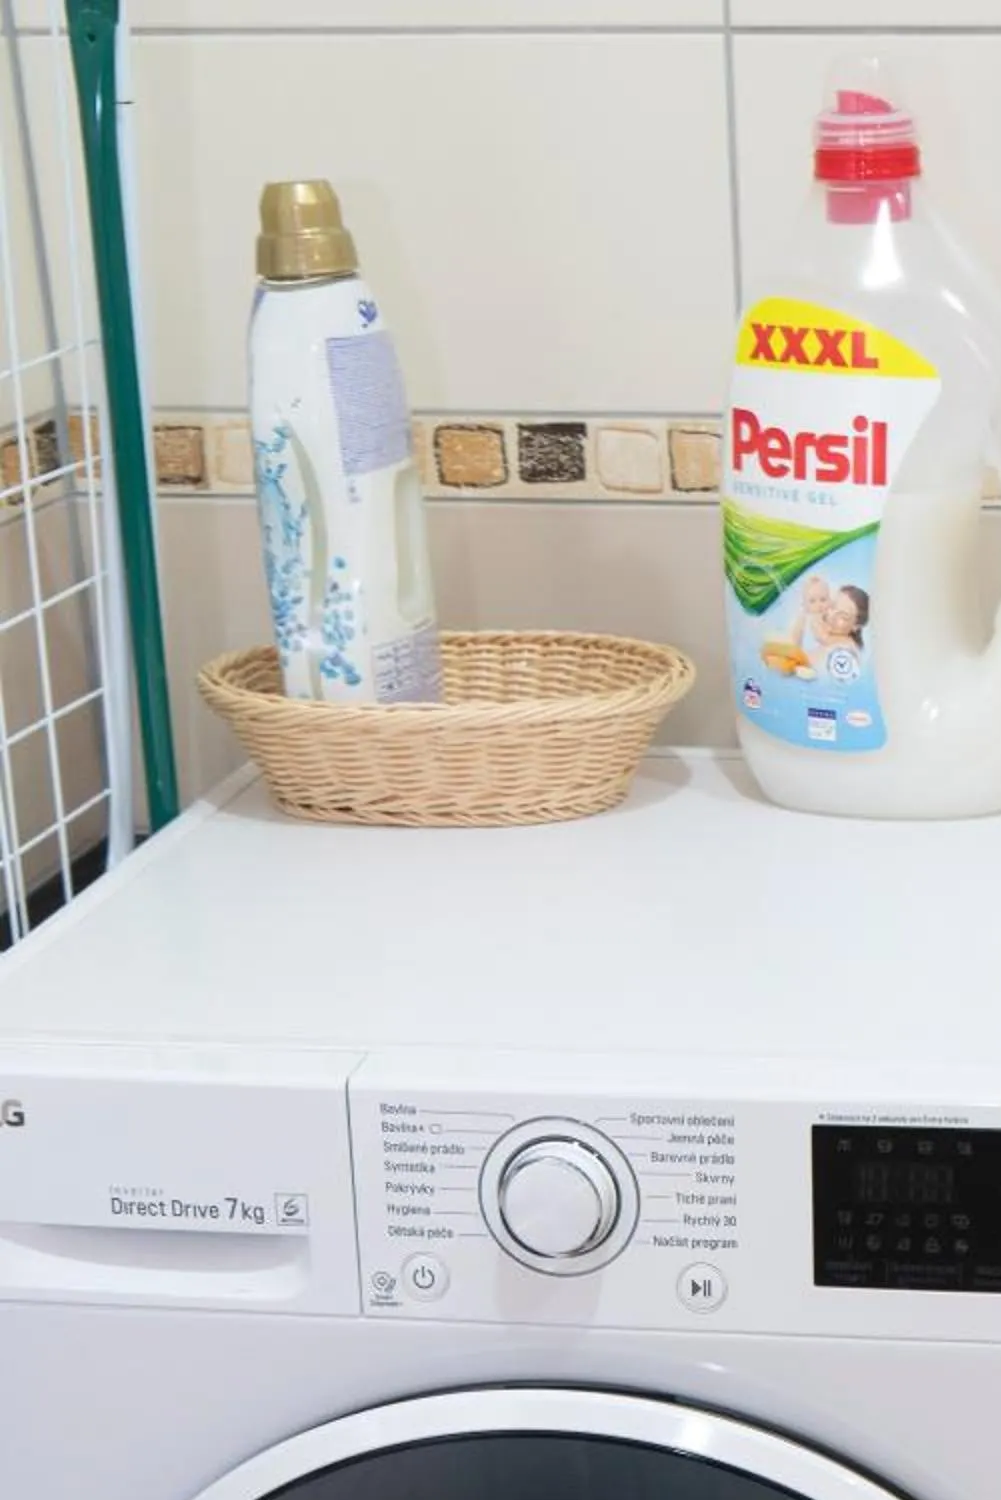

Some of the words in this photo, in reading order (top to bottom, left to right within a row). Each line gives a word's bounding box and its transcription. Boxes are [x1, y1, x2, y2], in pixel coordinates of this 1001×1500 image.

[750, 323, 879, 369] XXXL
[732, 407, 887, 486] Persil
[733, 481, 800, 503] SENSITIVE
[808, 490, 837, 507] GEL
[0, 1099, 25, 1127] G
[695, 1171, 735, 1185] Skvrny
[111, 1197, 166, 1217] Direct
[171, 1199, 220, 1219] Drive
[224, 1197, 238, 1219] 7
[241, 1202, 265, 1225] kg
